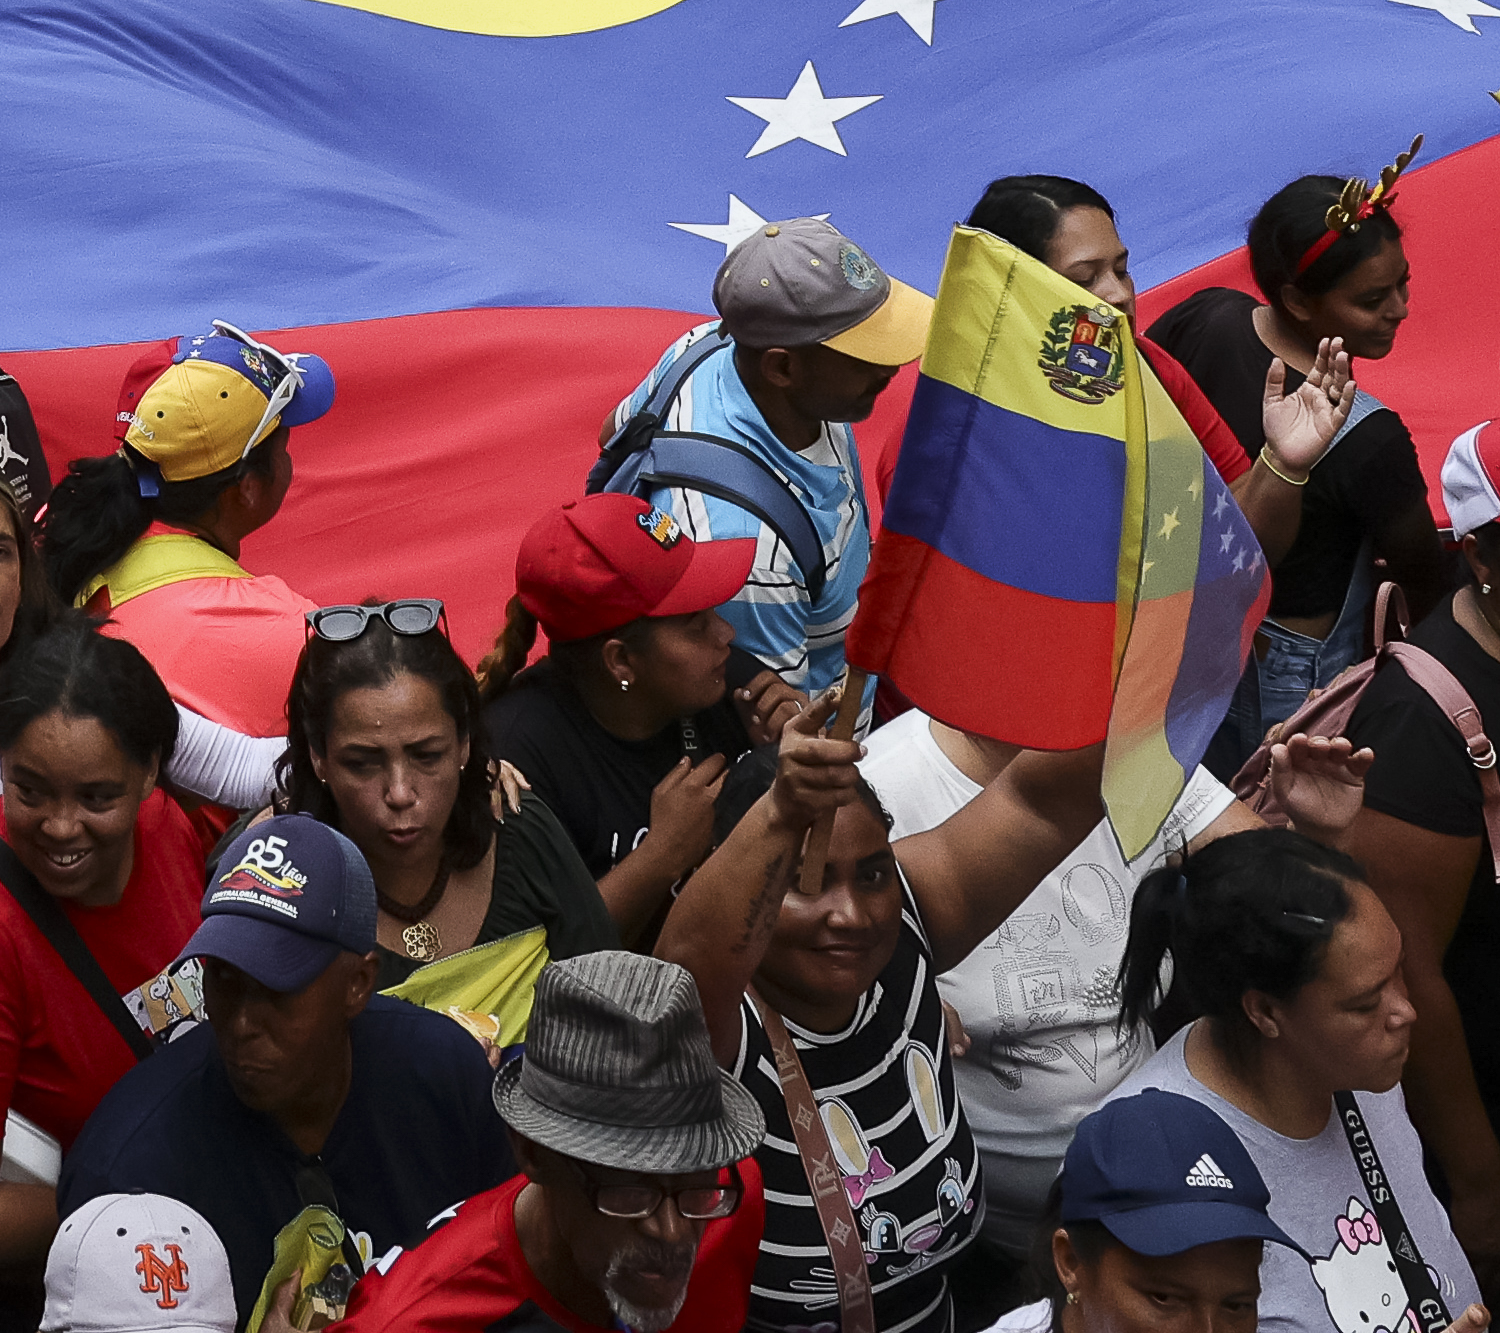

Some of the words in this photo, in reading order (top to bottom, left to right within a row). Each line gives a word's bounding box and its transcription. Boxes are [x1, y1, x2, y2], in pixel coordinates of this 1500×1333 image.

[243, 835, 288, 873] 85
[1185, 1172, 1234, 1190] adidas
[1344, 1108, 1390, 1206] GUESS
[135, 1243, 190, 1310] NY
